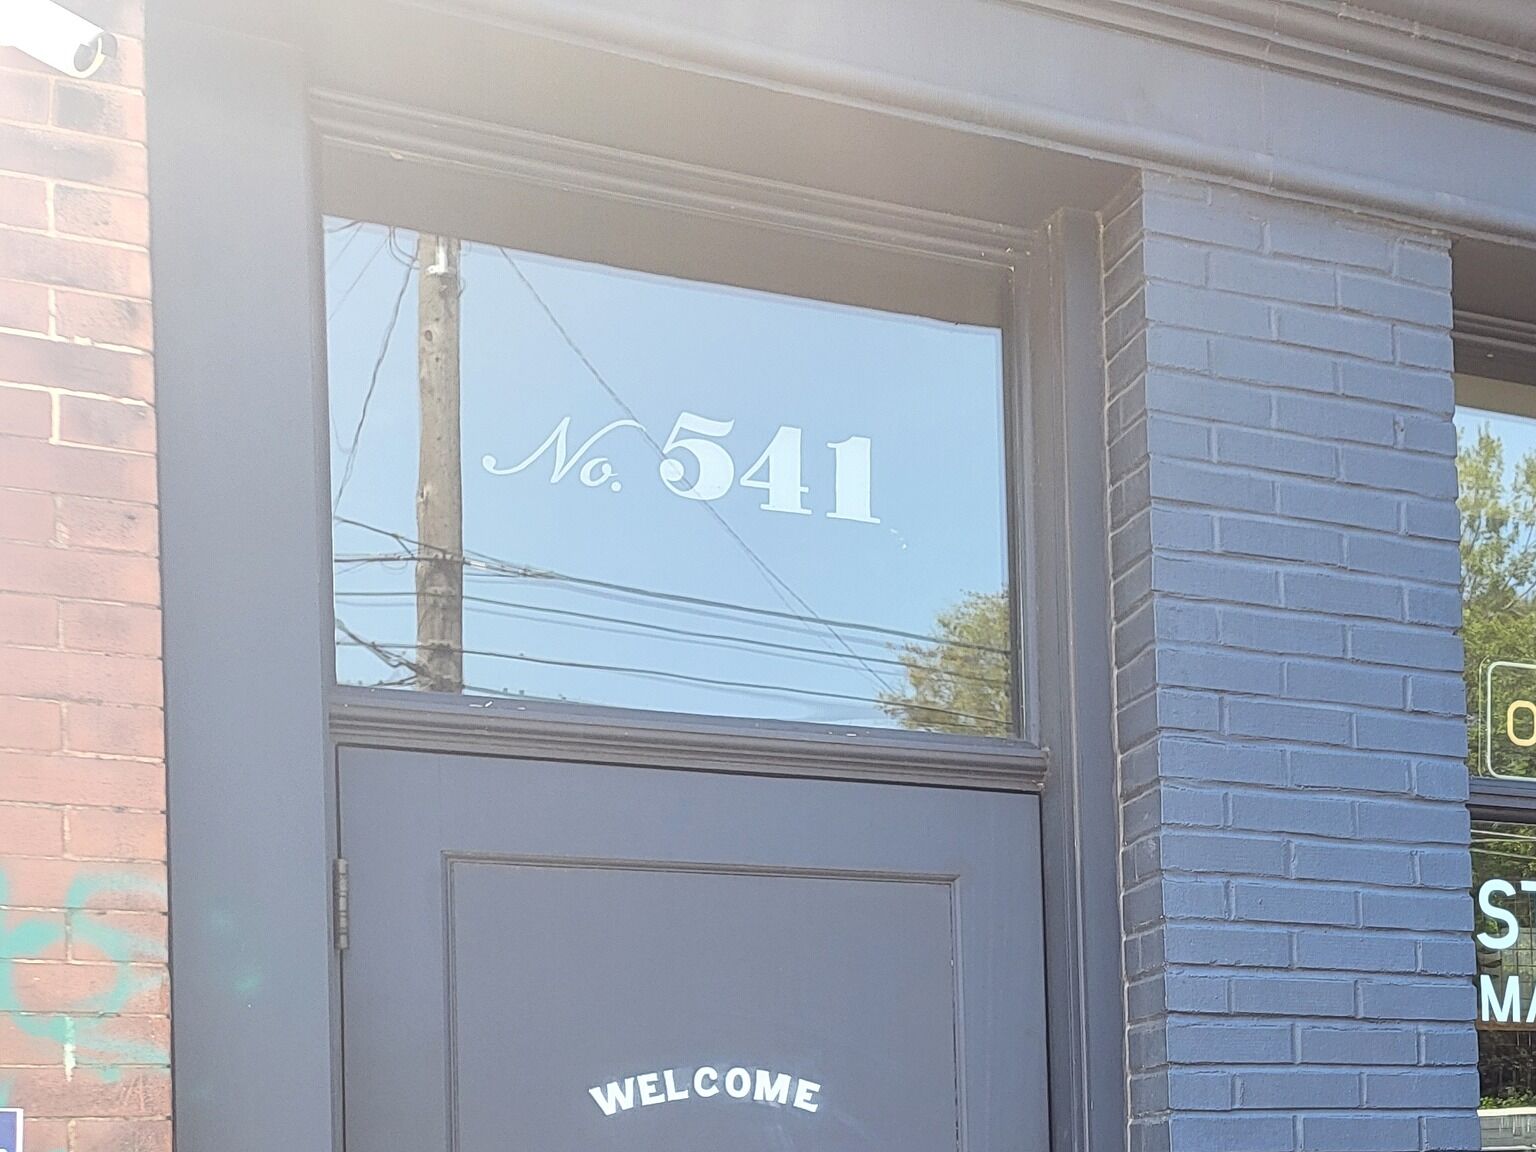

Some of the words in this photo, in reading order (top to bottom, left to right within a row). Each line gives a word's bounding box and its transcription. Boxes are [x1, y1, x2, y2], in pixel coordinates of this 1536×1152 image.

[481, 416, 646, 492] No.
[659, 411, 881, 524] 541
[588, 1066, 821, 1116] WELCOME
